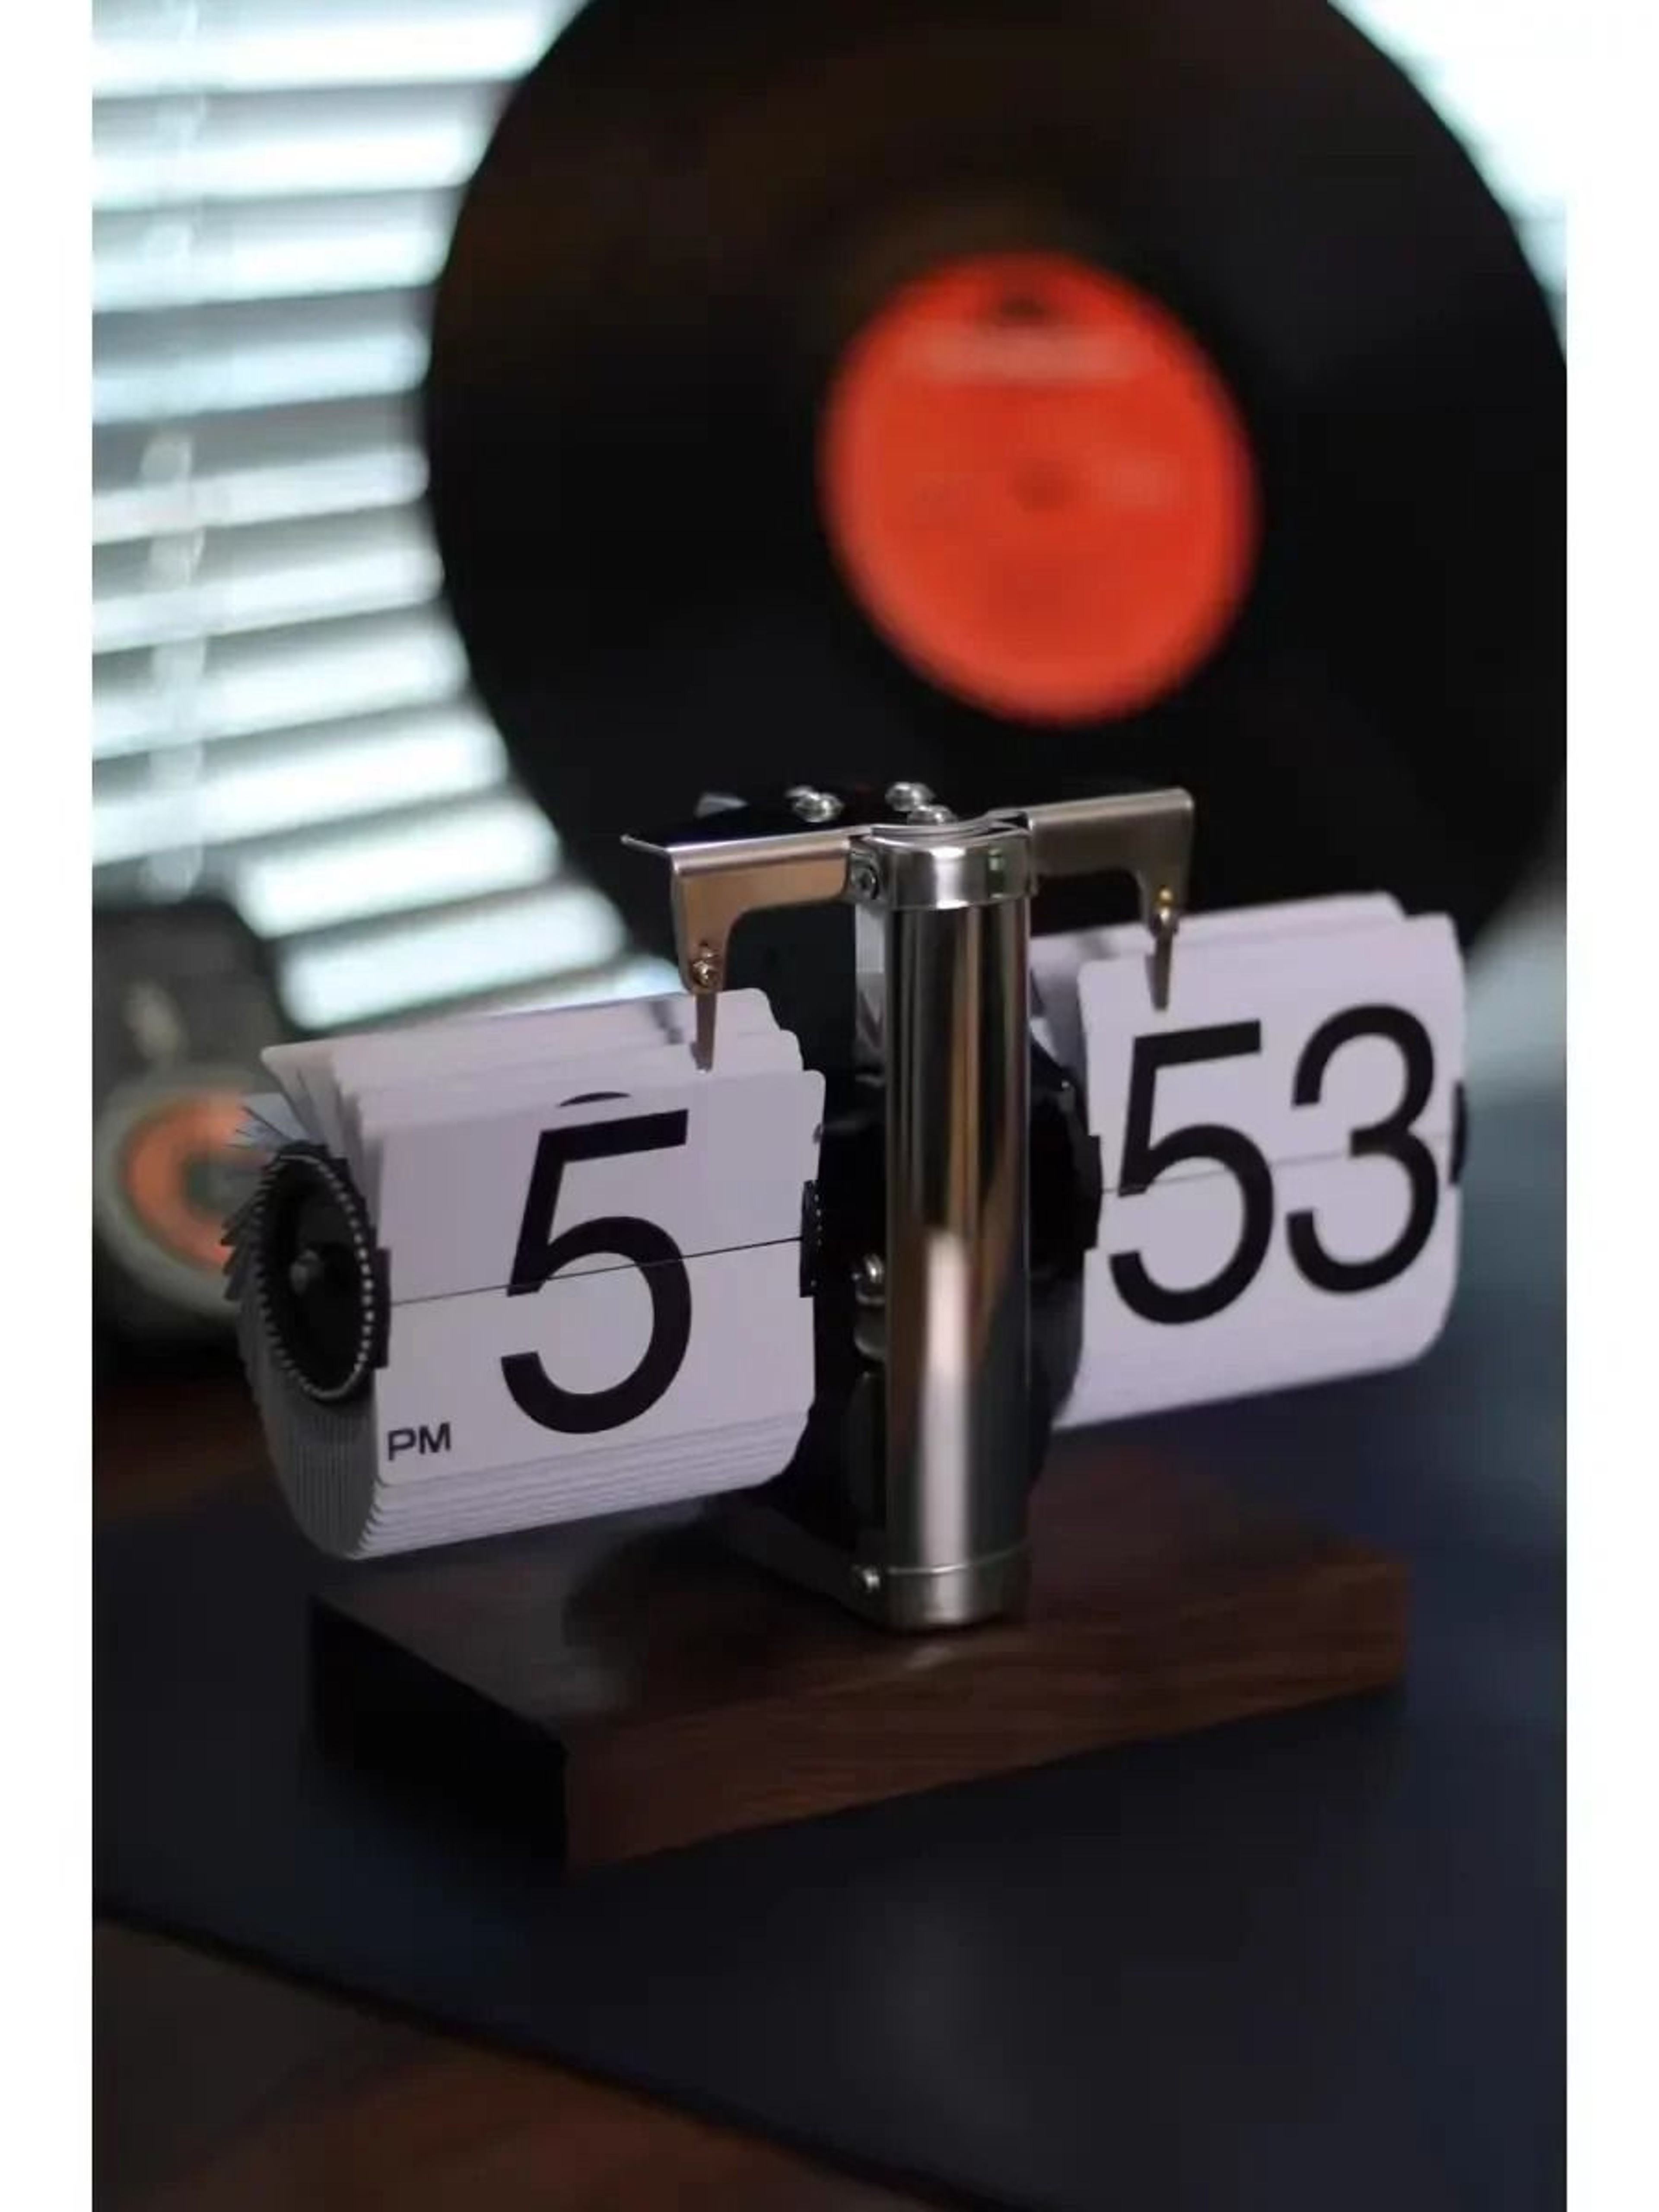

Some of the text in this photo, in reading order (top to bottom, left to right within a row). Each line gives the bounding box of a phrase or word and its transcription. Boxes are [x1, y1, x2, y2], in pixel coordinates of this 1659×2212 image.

[501, 1109, 692, 1434] 5
[1109, 1002, 1439, 1325] 53
[388, 1422, 450, 1461] PM
